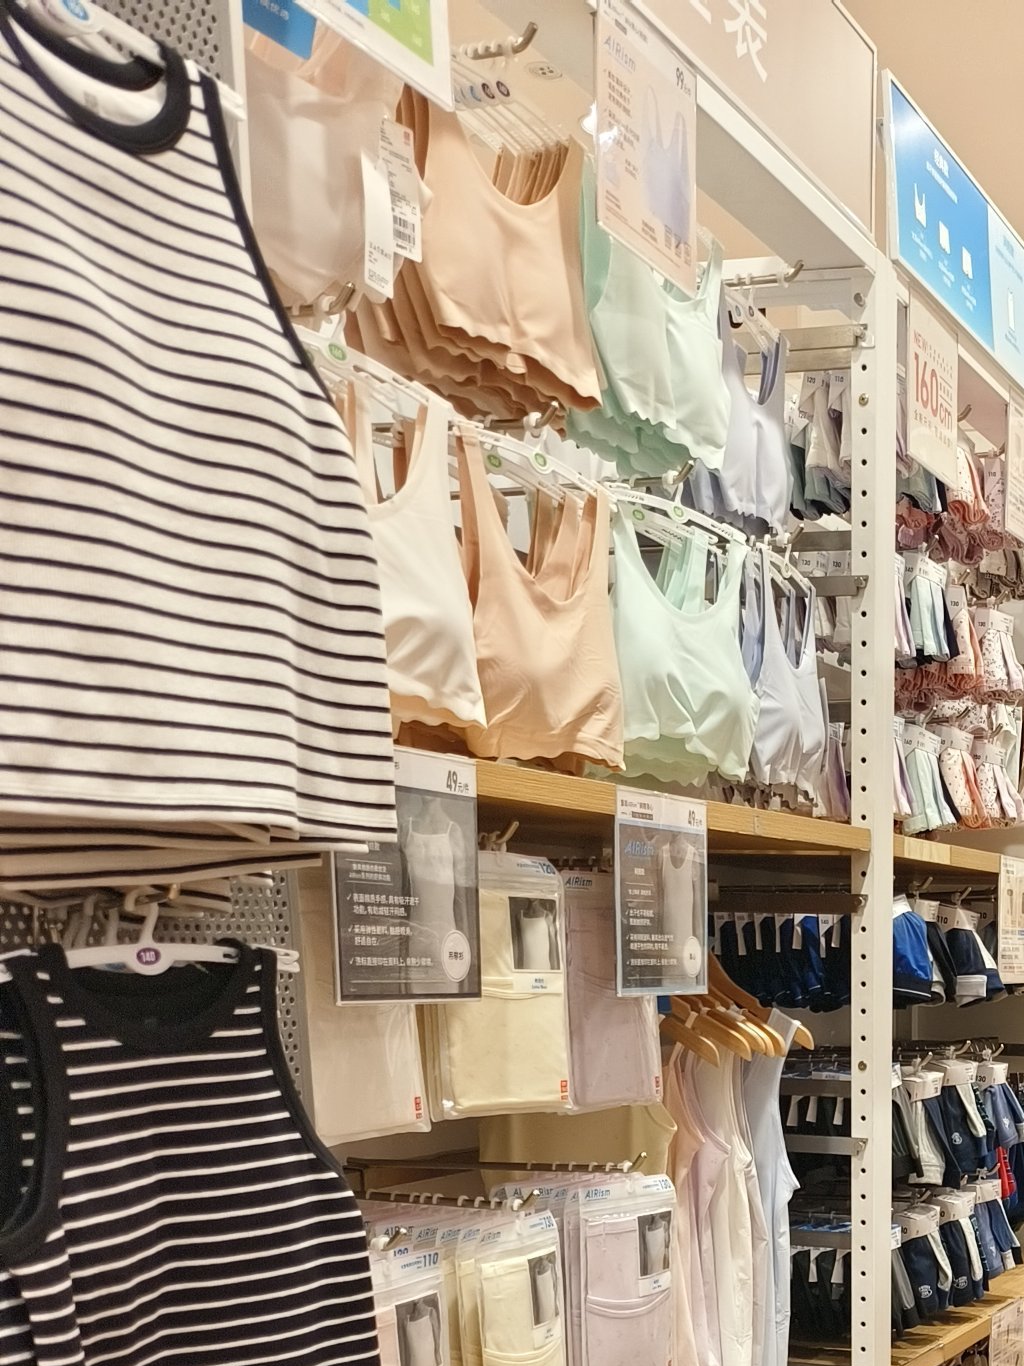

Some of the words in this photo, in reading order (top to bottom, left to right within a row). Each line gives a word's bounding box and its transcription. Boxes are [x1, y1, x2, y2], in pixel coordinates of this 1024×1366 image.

[675, 67, 684, 90] 99
[914, 351, 938, 418] 160
[939, 402, 952, 432] cm
[446, 769, 458, 792] 49
[688, 809, 696, 827] 49
[565, 876, 593, 887] AIRism
[140, 951, 156, 963] 140
[585, 1187, 611, 1200] AIRism
[423, 1251, 439, 1268] 110
